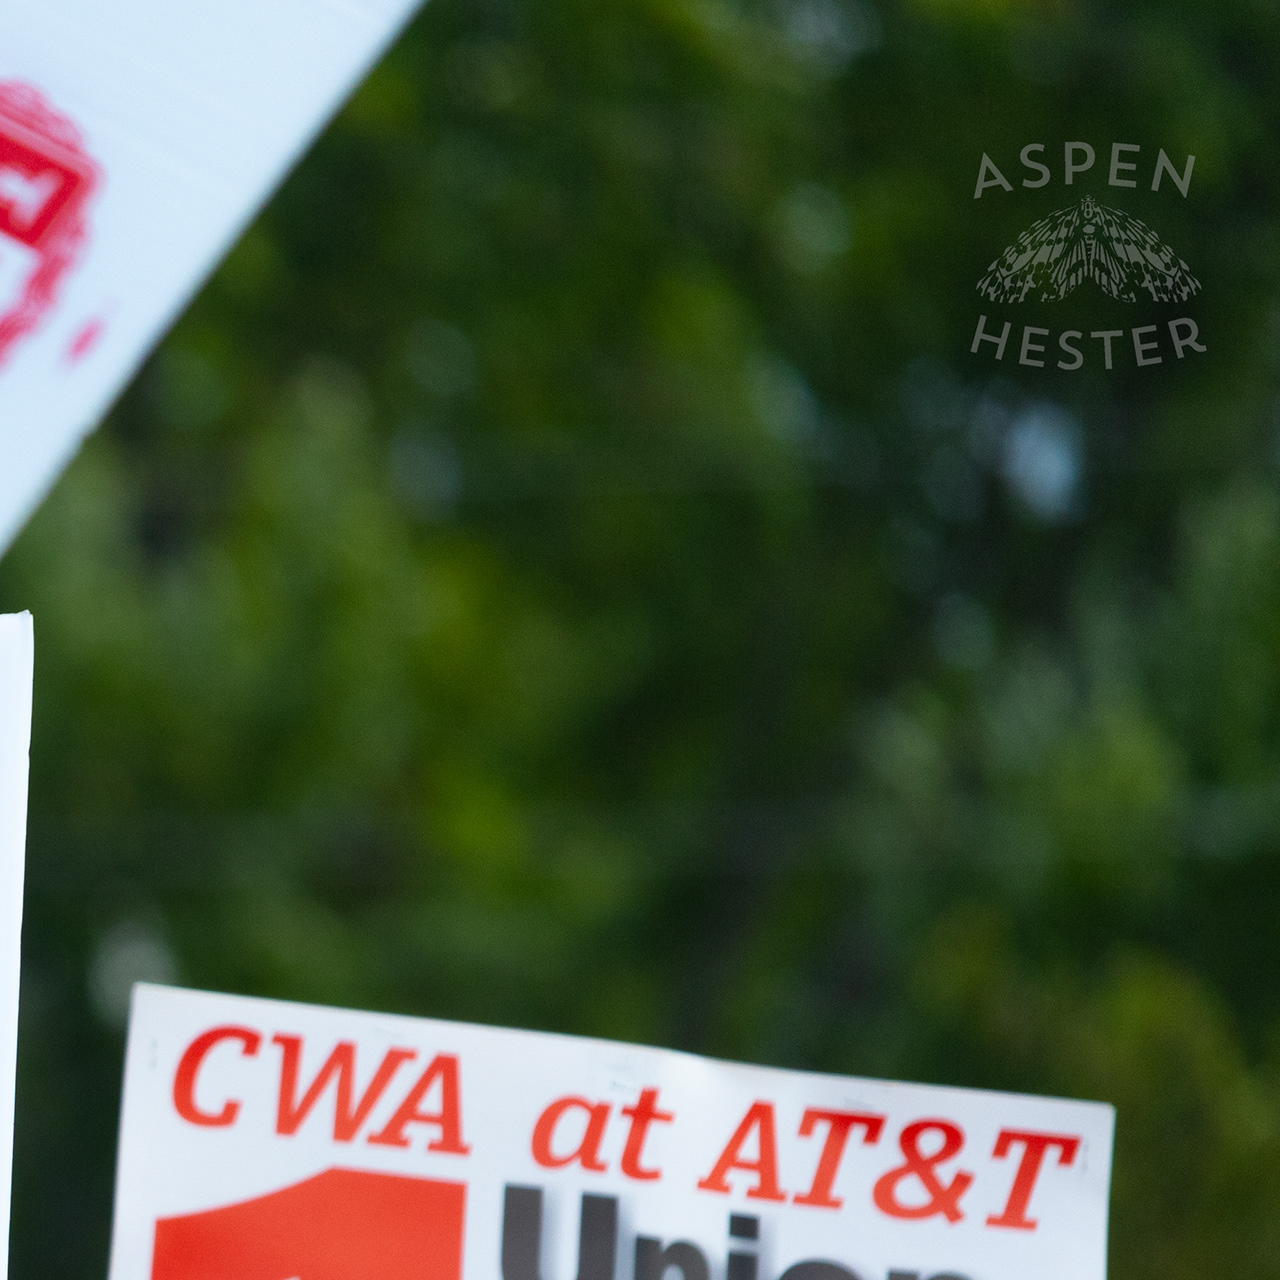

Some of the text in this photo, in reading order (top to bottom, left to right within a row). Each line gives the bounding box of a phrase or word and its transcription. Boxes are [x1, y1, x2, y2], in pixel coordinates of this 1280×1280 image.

[172, 1024, 1082, 1232] CWA at AT&T
